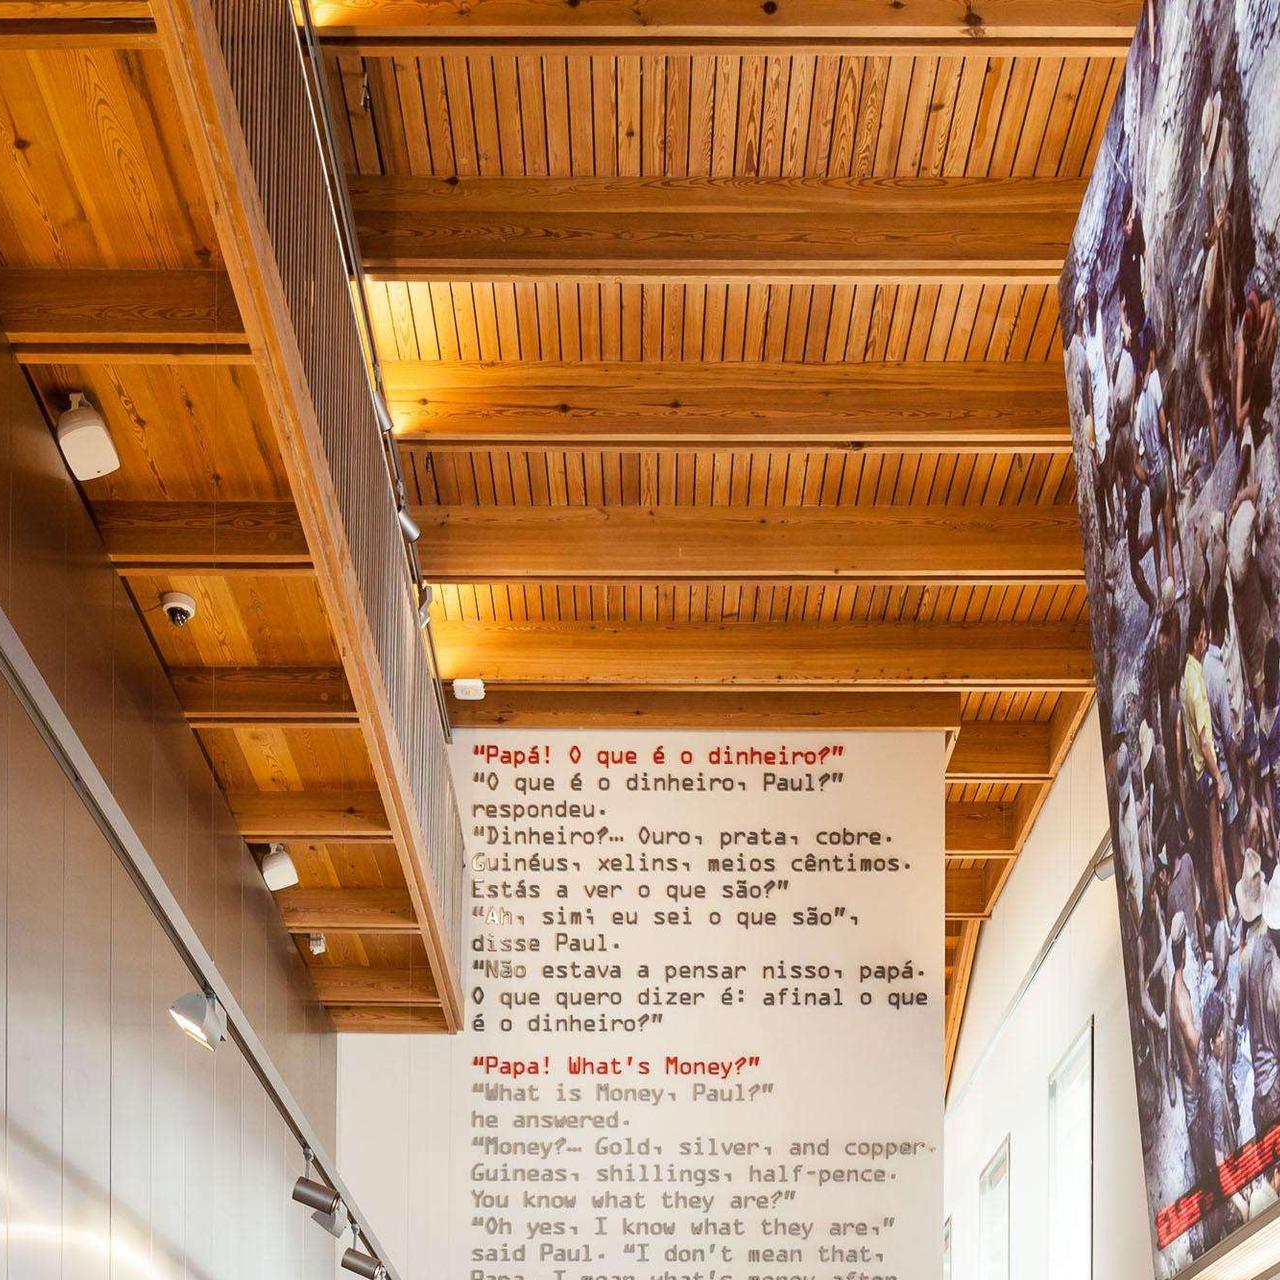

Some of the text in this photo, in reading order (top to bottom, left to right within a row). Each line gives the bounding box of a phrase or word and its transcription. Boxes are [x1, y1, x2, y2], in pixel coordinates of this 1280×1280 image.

[567, 745, 581, 764] O
[595, 750, 640, 769] que
[651, 745, 667, 764] é
[680, 750, 694, 765] o
[514, 777, 555, 795] que
[569, 772, 582, 791] é
[597, 777, 610, 791] o
[624, 772, 747, 792] dinheiro,
[471, 800, 605, 822] respondeu.
[637, 826, 704, 846] Ouro,
[720, 828, 798, 850] prata,
[816, 827, 892, 845] cobre.
[472, 852, 910, 872] Guinéus, xelins, meios cêntimos.
[471, 933, 619, 952] disse Paul.
[472, 960, 925, 983] “Não estava a pensar nisso, papá.
[471, 986, 929, 1010] O que quero dizer é: afinal o que
[556, 1082, 581, 1101] is
[596, 1083, 676, 1106] Money,
[470, 1163, 896, 1187] Guineas, shillings, half-pence.
